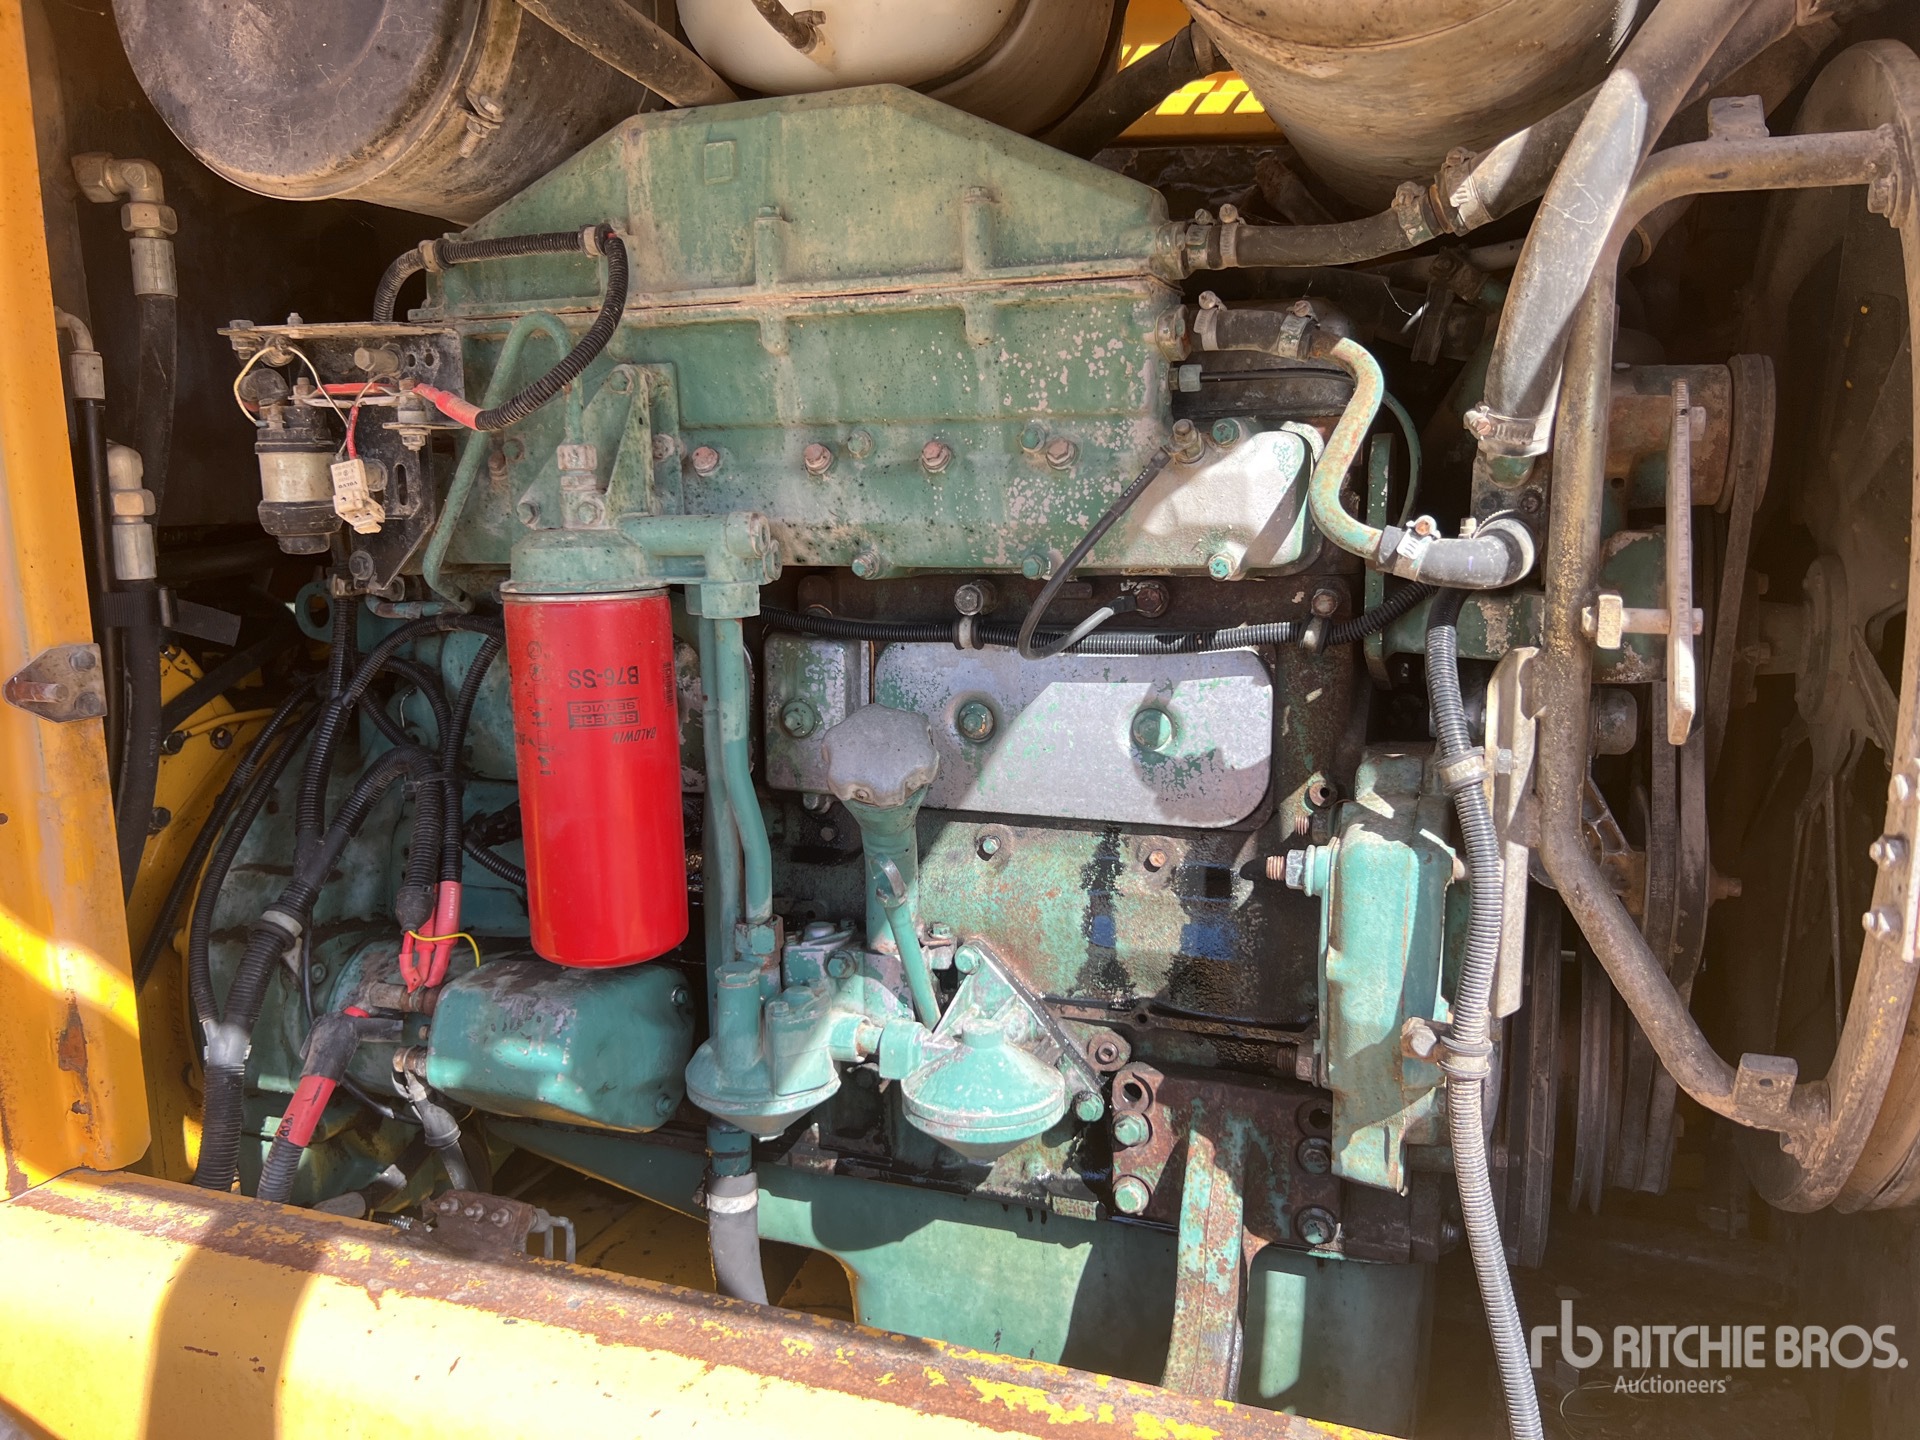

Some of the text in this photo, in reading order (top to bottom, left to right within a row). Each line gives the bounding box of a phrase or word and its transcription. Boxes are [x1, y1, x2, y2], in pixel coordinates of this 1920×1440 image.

[568, 665, 640, 689] B76-SS
[574, 714, 636, 727] SEVERE
[612, 726, 657, 744] BALDWIN
